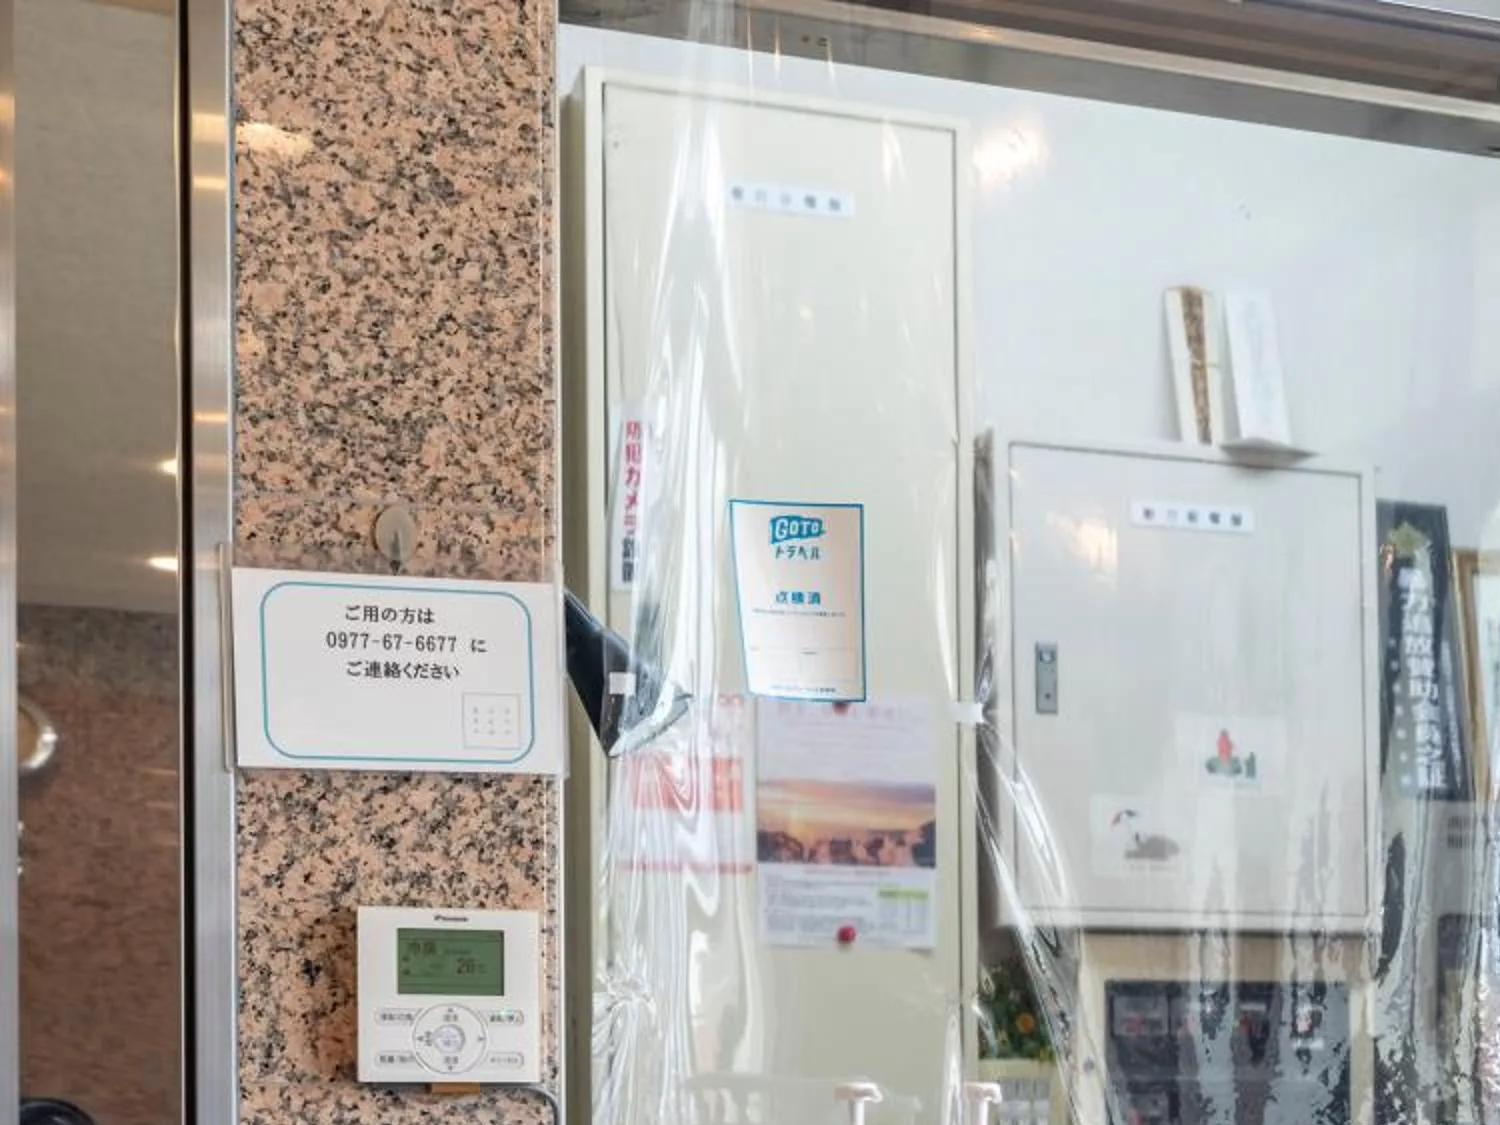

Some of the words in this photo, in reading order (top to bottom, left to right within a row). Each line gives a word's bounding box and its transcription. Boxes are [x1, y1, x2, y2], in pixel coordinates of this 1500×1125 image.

[345, 605, 435, 625] ご用の方は
[326, 631, 457, 653] 0977-67-6677
[470, 638, 488, 653] に
[346, 660, 460, 680] ご連絡ください
